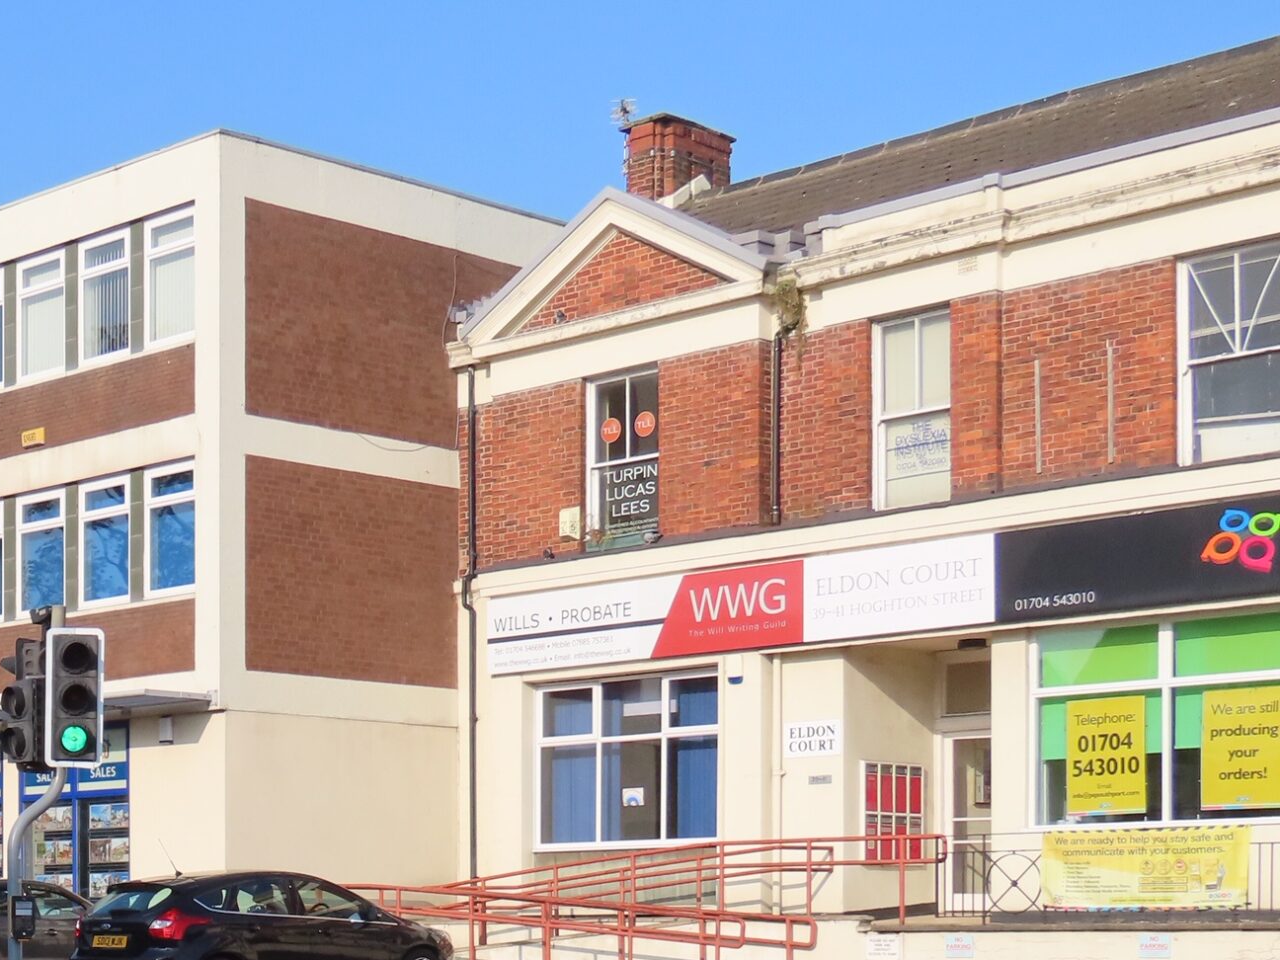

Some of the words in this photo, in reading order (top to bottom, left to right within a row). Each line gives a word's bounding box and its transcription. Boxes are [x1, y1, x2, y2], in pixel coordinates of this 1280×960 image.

[603, 427, 619, 435] TLL
[636, 420, 653, 429] TLL
[895, 429, 948, 446] DYSLEXIA
[603, 463, 658, 484] TURPIN
[605, 481, 656, 501] LUCAS
[612, 499, 650, 517] LEES
[816, 569, 890, 597] ELDON
[899, 557, 983, 585] COURT
[689, 578, 786, 622] WWG
[850, 595, 929, 616] HOGHTON
[932, 587, 985, 606] STREET
[1014, 593, 1049, 611] 01704
[1053, 591, 1096, 608] 543010
[493, 613, 540, 632] WILLS
[561, 601, 632, 624] PROBATE
[689, 629, 704, 637] The
[707, 627, 724, 635] Will
[727, 623, 760, 632] Writing
[763, 620, 786, 629] Guild
[1211, 703, 1233, 715] We
[1236, 704, 1256, 715] are
[1260, 700, 1279, 713] still
[1073, 712, 1136, 728] Telephone:
[789, 725, 836, 739] ELDON
[1210, 723, 1279, 741] producing
[789, 739, 836, 752] COURT
[1077, 732, 1133, 753] 01704
[1228, 748, 1259, 762] your
[90, 765, 117, 779] SALES
[1072, 756, 1140, 777] 543010
[1219, 767, 1268, 781] orders!
[1055, 837, 1068, 845] We
[1070, 837, 1086, 845] are
[1087, 836, 1114, 846] ready
[1117, 836, 1127, 844] to
[1129, 835, 1150, 844] help
[1152, 836, 1168, 844] you
[1170, 835, 1188, 844] stay
[1190, 833, 1212, 842] safe
[1214, 832, 1234, 841] and
[1062, 847, 1125, 856] communicate
[1127, 846, 1148, 855] with
[1149, 847, 1171, 857] your
[946, 943, 972, 951] PARKING
[1140, 943, 1168, 951] PARKING
